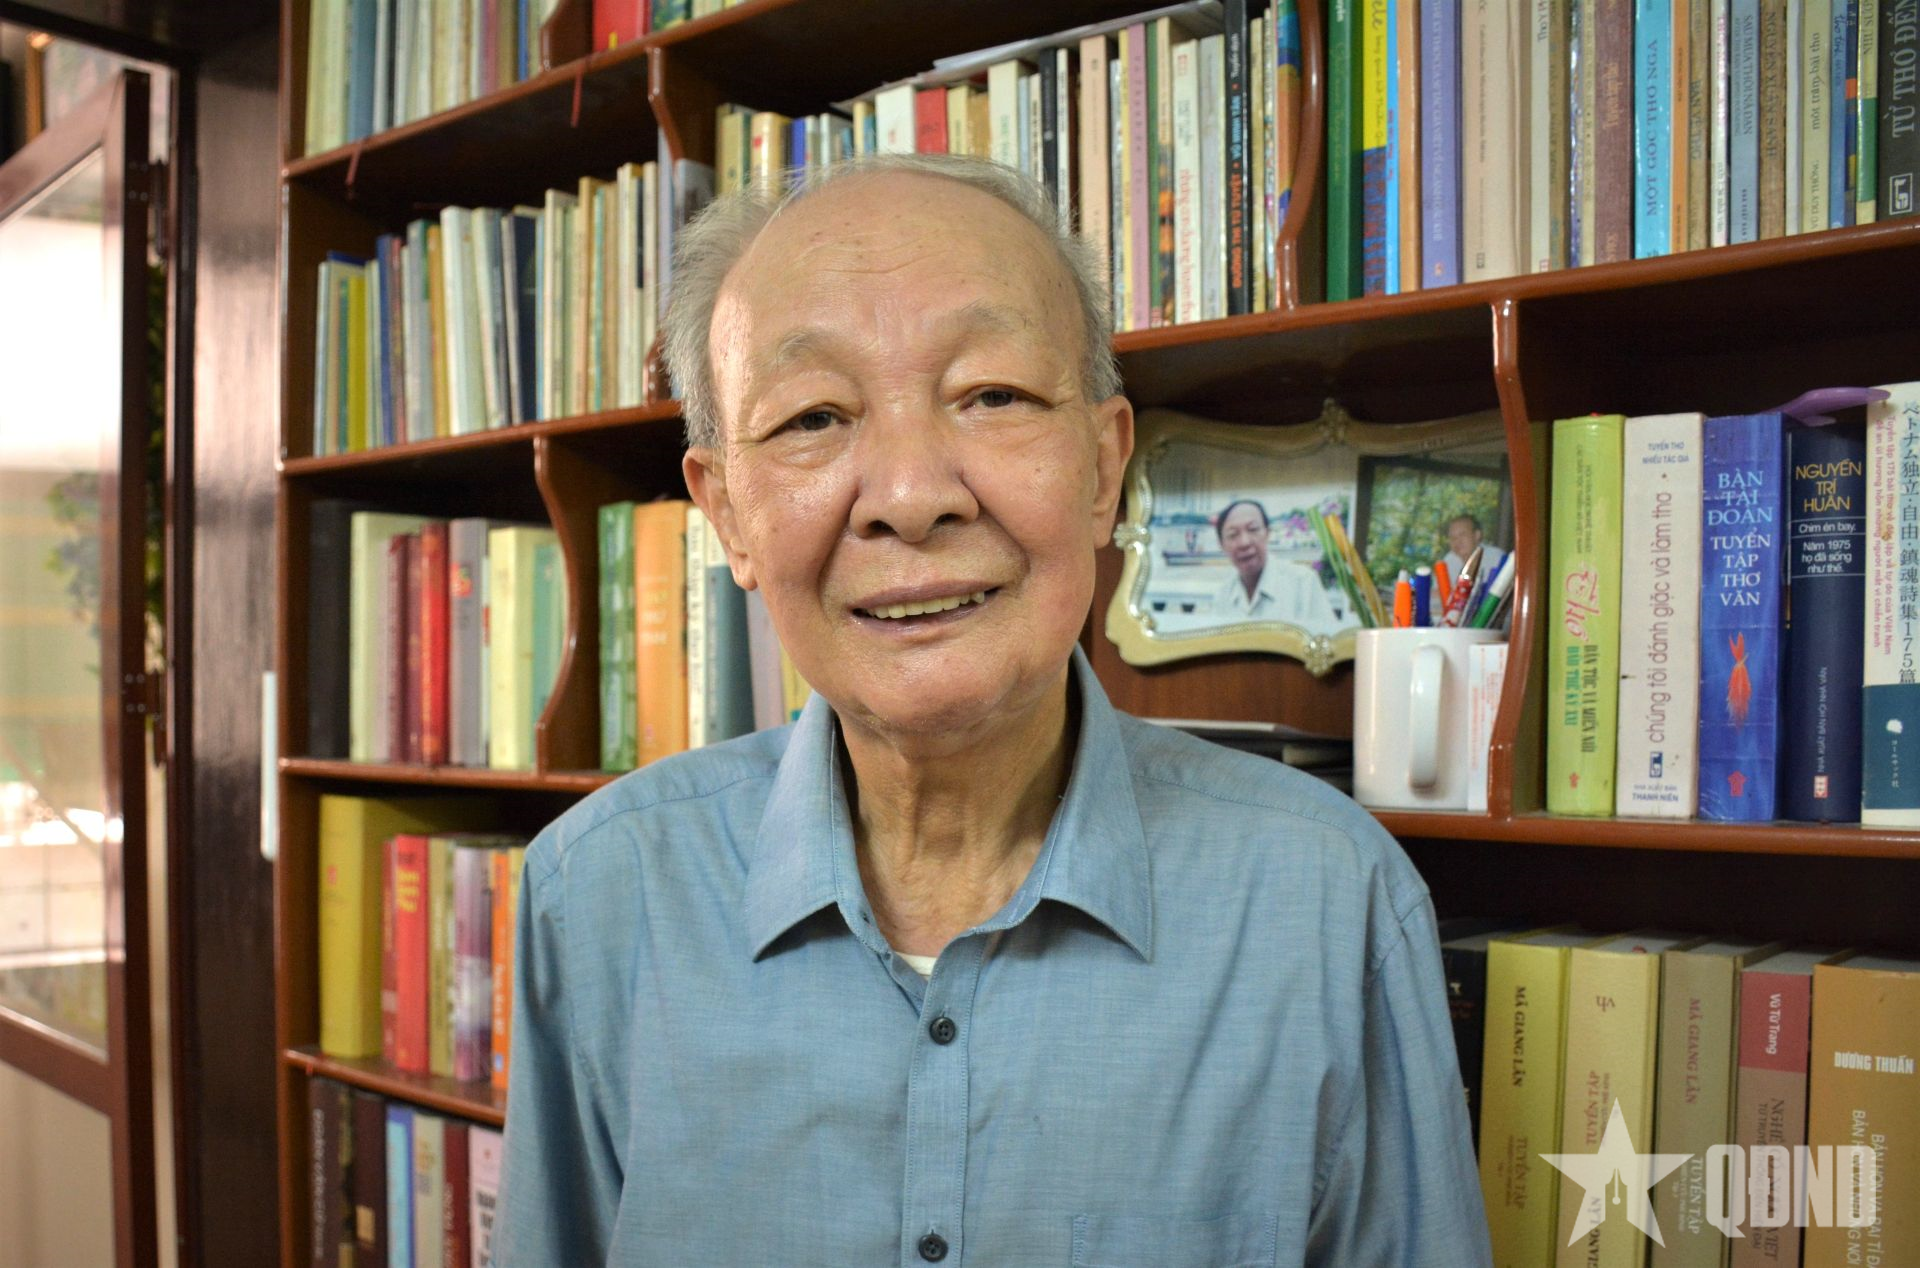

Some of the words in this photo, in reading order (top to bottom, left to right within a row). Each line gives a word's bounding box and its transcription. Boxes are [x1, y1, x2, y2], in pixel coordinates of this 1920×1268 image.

[1743, 14, 1753, 36] SAU
[1766, 11, 1782, 71] NGUYỄN
[1646, 40, 1657, 79] NGA
[1888, 48, 1916, 99] THƠ
[1645, 86, 1658, 126] THƠ
[1766, 74, 1780, 113] XUÂN
[1810, 106, 1820, 130] một
[1883, 106, 1916, 138] TỪ
[1644, 130, 1658, 170] GÓC
[1766, 117, 1777, 158] SANH
[1644, 176, 1658, 216] MỘT
[1883, 416, 1896, 442] Tuyển
[1884, 444, 1895, 458] tập
[1718, 468, 1764, 489] BÀN
[1795, 460, 1862, 480] NGUYỄN
[1874, 457, 1884, 487] hương
[1887, 462, 1895, 476] 175
[1815, 478, 1836, 496] TRÍ
[1887, 478, 1896, 492] bài
[1708, 505, 1773, 526] ĐOÀN
[1804, 494, 1850, 512] HUÂN
[1798, 523, 1822, 534] Chim
[1874, 508, 1884, 538] những
[1650, 522, 1672, 553] làm
[1710, 528, 1772, 550] TUYỂN
[1803, 542, 1825, 552] Năm
[1828, 540, 1851, 550] 1975
[1650, 557, 1670, 578] và
[1722, 552, 1760, 572] TẬP
[1802, 554, 1813, 564] họ
[1814, 552, 1826, 562] đã
[1828, 551, 1852, 564] sống
[1874, 540, 1882, 568] người
[1720, 572, 1762, 588] THƠ
[1807, 562, 1826, 574] như
[1650, 582, 1674, 618] giặc
[1720, 589, 1760, 606] VĂN
[1886, 583, 1894, 595] do
[1885, 597, 1894, 614] của
[1884, 615, 1893, 633] Việt
[1648, 622, 1668, 664] đánh
[1884, 635, 1892, 655] Nam
[1648, 668, 1667, 688] tôi
[1646, 692, 1672, 743] chúng
[1632, 792, 1658, 800] THANH
[1768, 993, 1782, 1008] Vũ
[1512, 1010, 1526, 1056] GIANG
[1766, 1023, 1780, 1055] Trang
[1686, 1024, 1701, 1071] GIANG
[1512, 1058, 1527, 1087] LÂN
[1834, 1051, 1872, 1071] DƯƠNG
[1875, 1054, 1914, 1074] THUẤN
[1585, 1070, 1601, 1097] TẬP
[1684, 1074, 1702, 1104] LÂN
[1584, 1100, 1598, 1146] TUYỂN
[1769, 1097, 1786, 1143] NGHỀ
[1852, 1110, 1869, 1138] BẢN
[1514, 1136, 1531, 1180] TUYỂN
[1871, 1134, 1888, 1161] BẢN
[1690, 1157, 1706, 1204] TUYỂN
[1512, 1184, 1528, 1211] TẬP
[1686, 1207, 1704, 1234] TẬP
[1764, 1226, 1780, 1262] VIỆT
[1846, 1242, 1862, 1265] NƠI
